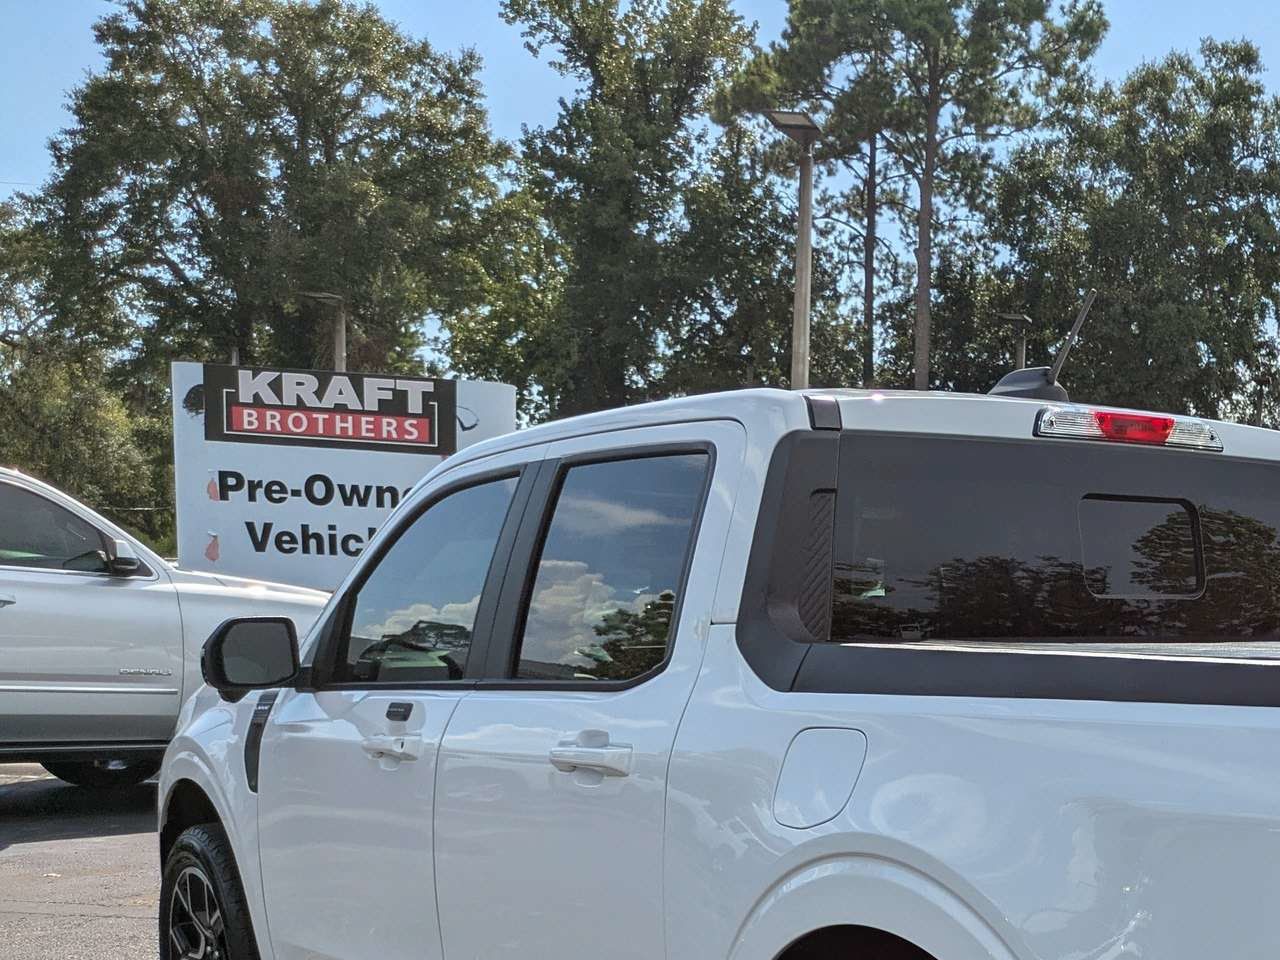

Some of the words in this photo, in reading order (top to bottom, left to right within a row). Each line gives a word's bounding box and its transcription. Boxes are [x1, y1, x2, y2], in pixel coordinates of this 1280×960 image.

[238, 370, 434, 414] KRAFT
[243, 409, 420, 440] BROTHERS
[218, 470, 412, 509] Pre-Own
